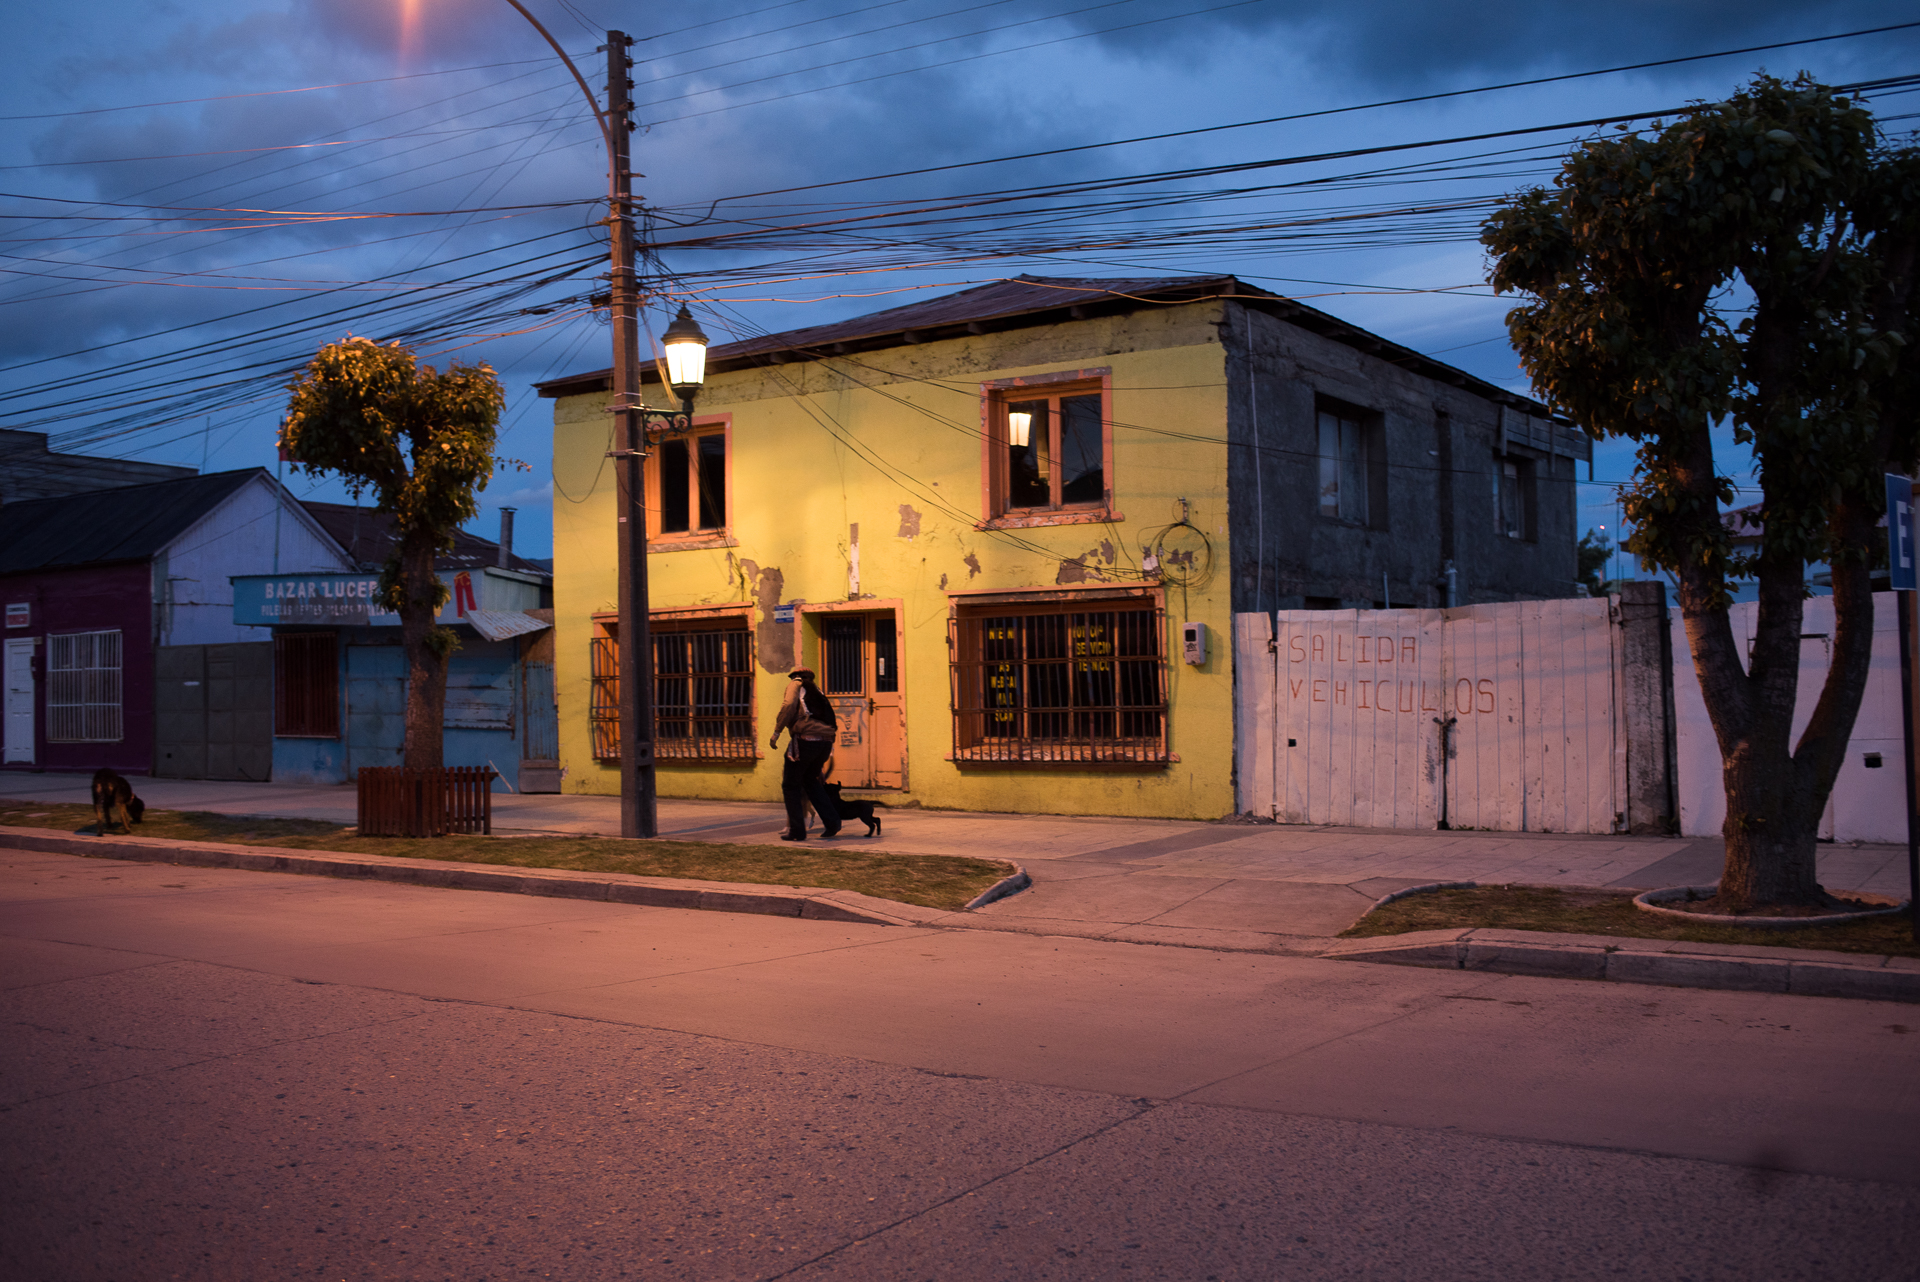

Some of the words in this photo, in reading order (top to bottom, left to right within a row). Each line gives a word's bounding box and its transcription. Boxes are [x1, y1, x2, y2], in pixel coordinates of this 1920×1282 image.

[1896, 500, 1911, 569] E
[265, 582, 316, 599] BAZAR
[321, 581, 379, 598] LUCER
[1076, 641, 1111, 655] SEVICIO
[1290, 634, 1416, 664] SALIDA
[1078, 658, 1110, 672] TENCO
[990, 676, 1017, 688] WEBCA
